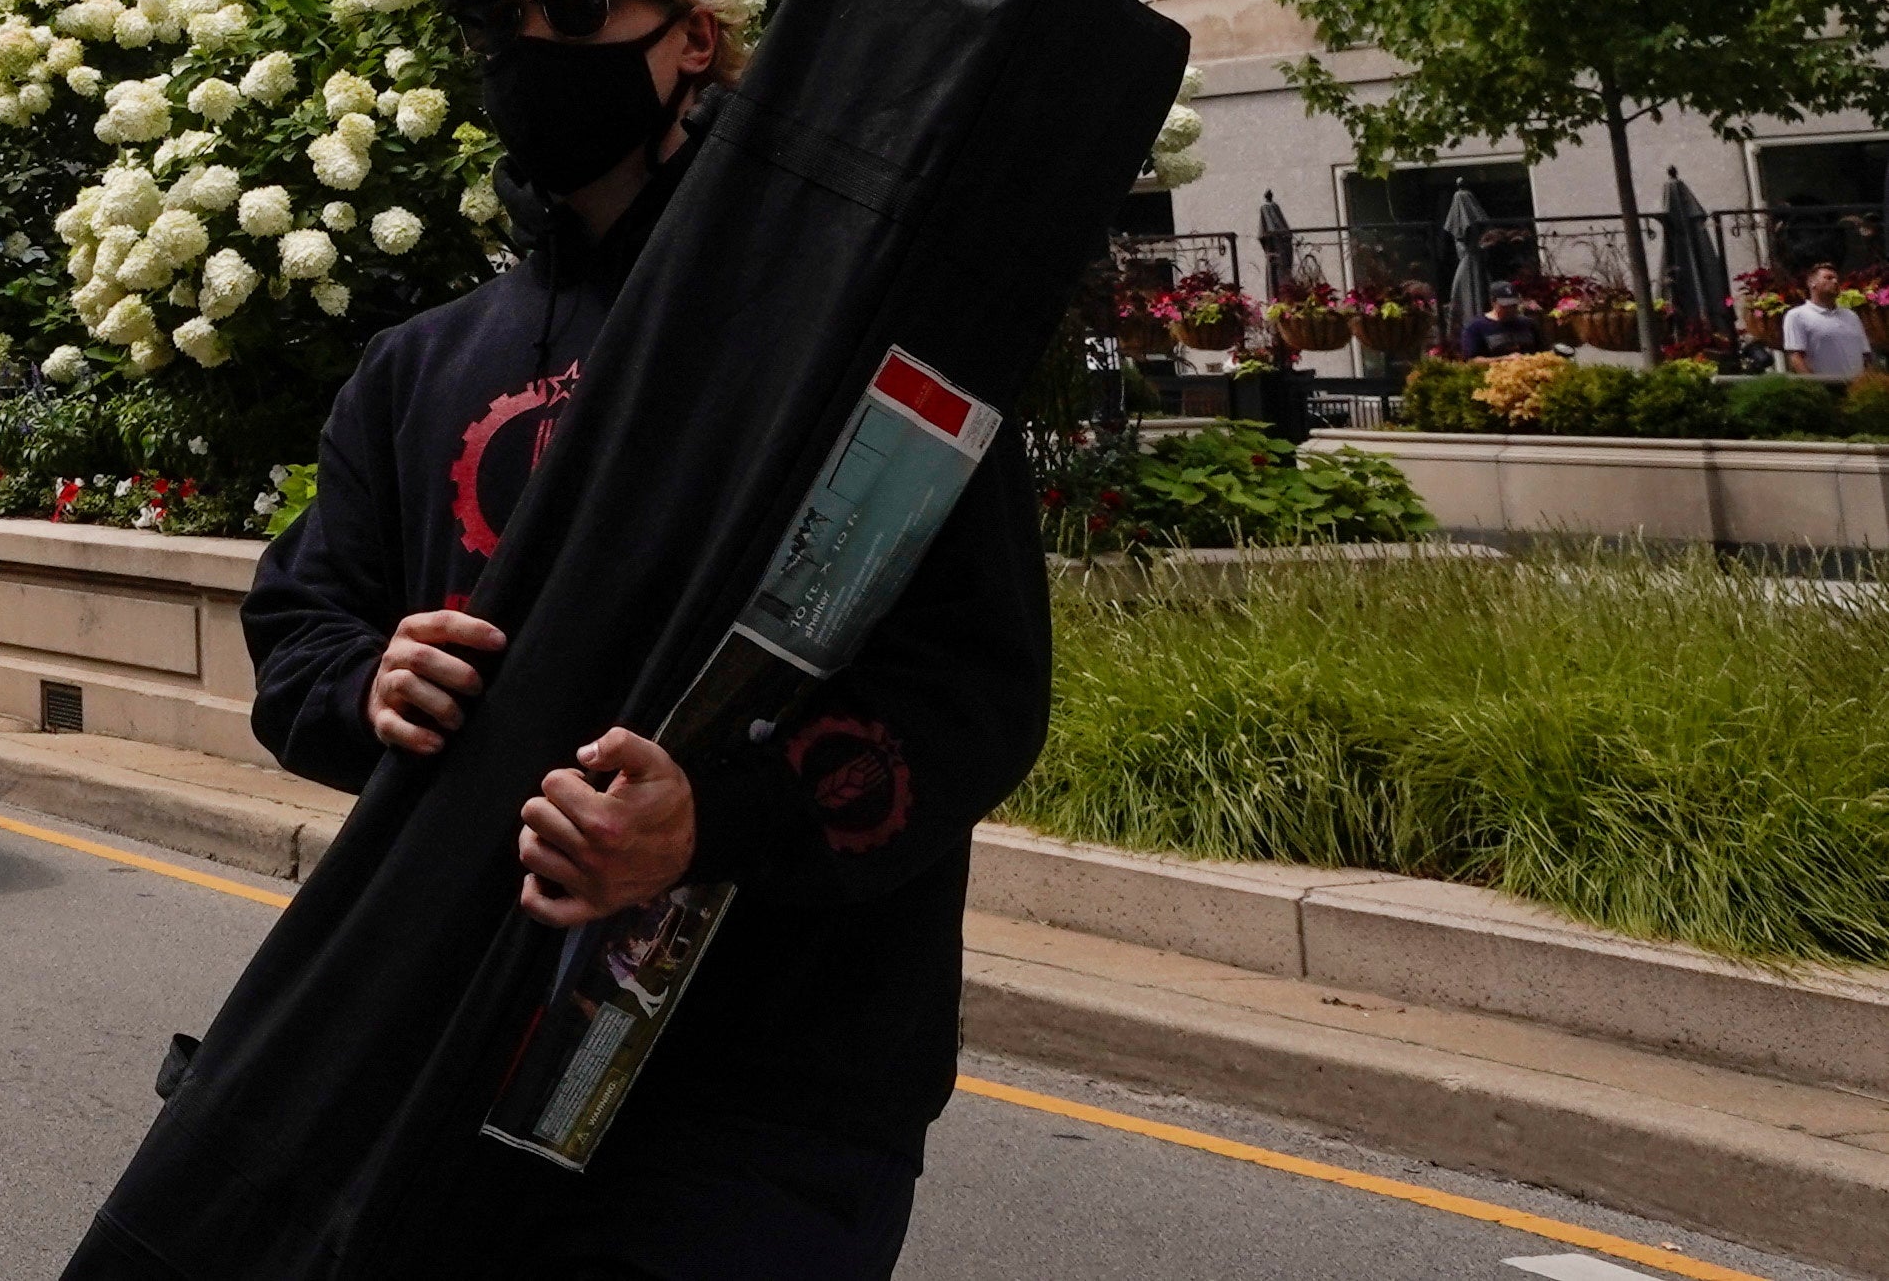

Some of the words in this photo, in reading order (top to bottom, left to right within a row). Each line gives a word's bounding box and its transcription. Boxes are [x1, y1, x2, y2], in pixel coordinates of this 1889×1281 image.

[790, 605, 807, 629] 10
[833, 531, 847, 552] 10
[805, 590, 831, 639] shelter
